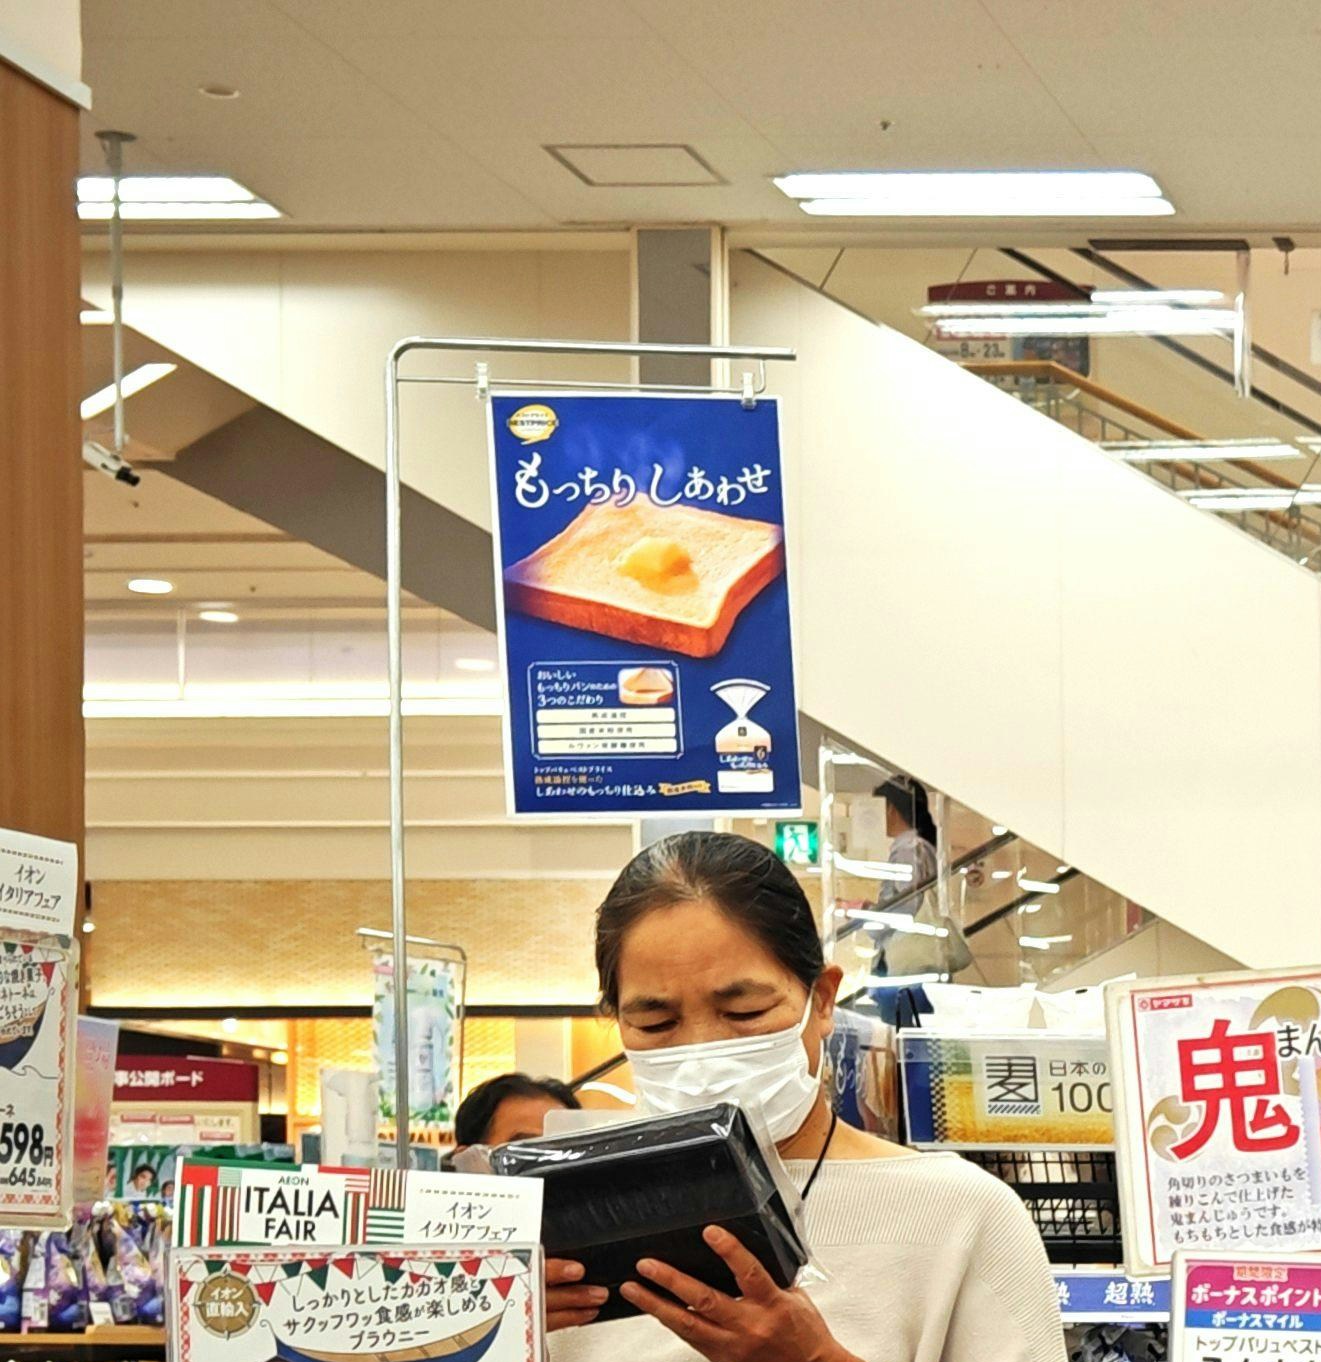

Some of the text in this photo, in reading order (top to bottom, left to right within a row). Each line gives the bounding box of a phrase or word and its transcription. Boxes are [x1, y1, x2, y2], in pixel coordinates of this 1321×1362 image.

[514, 452, 773, 508] もっちり しあわせ
[14, 864, 47, 885] イオン
[1170, 1017, 1300, 1161] 鬼
[245, 1185, 340, 1219] ITALIA
[446, 1200, 493, 1220] イオン
[264, 1218, 317, 1242] FAIR
[417, 1219, 518, 1243] イタリアフェア
[1211, 1311, 1304, 1329] ボーナスマイル
[350, 1326, 431, 1350] ブラウニー
